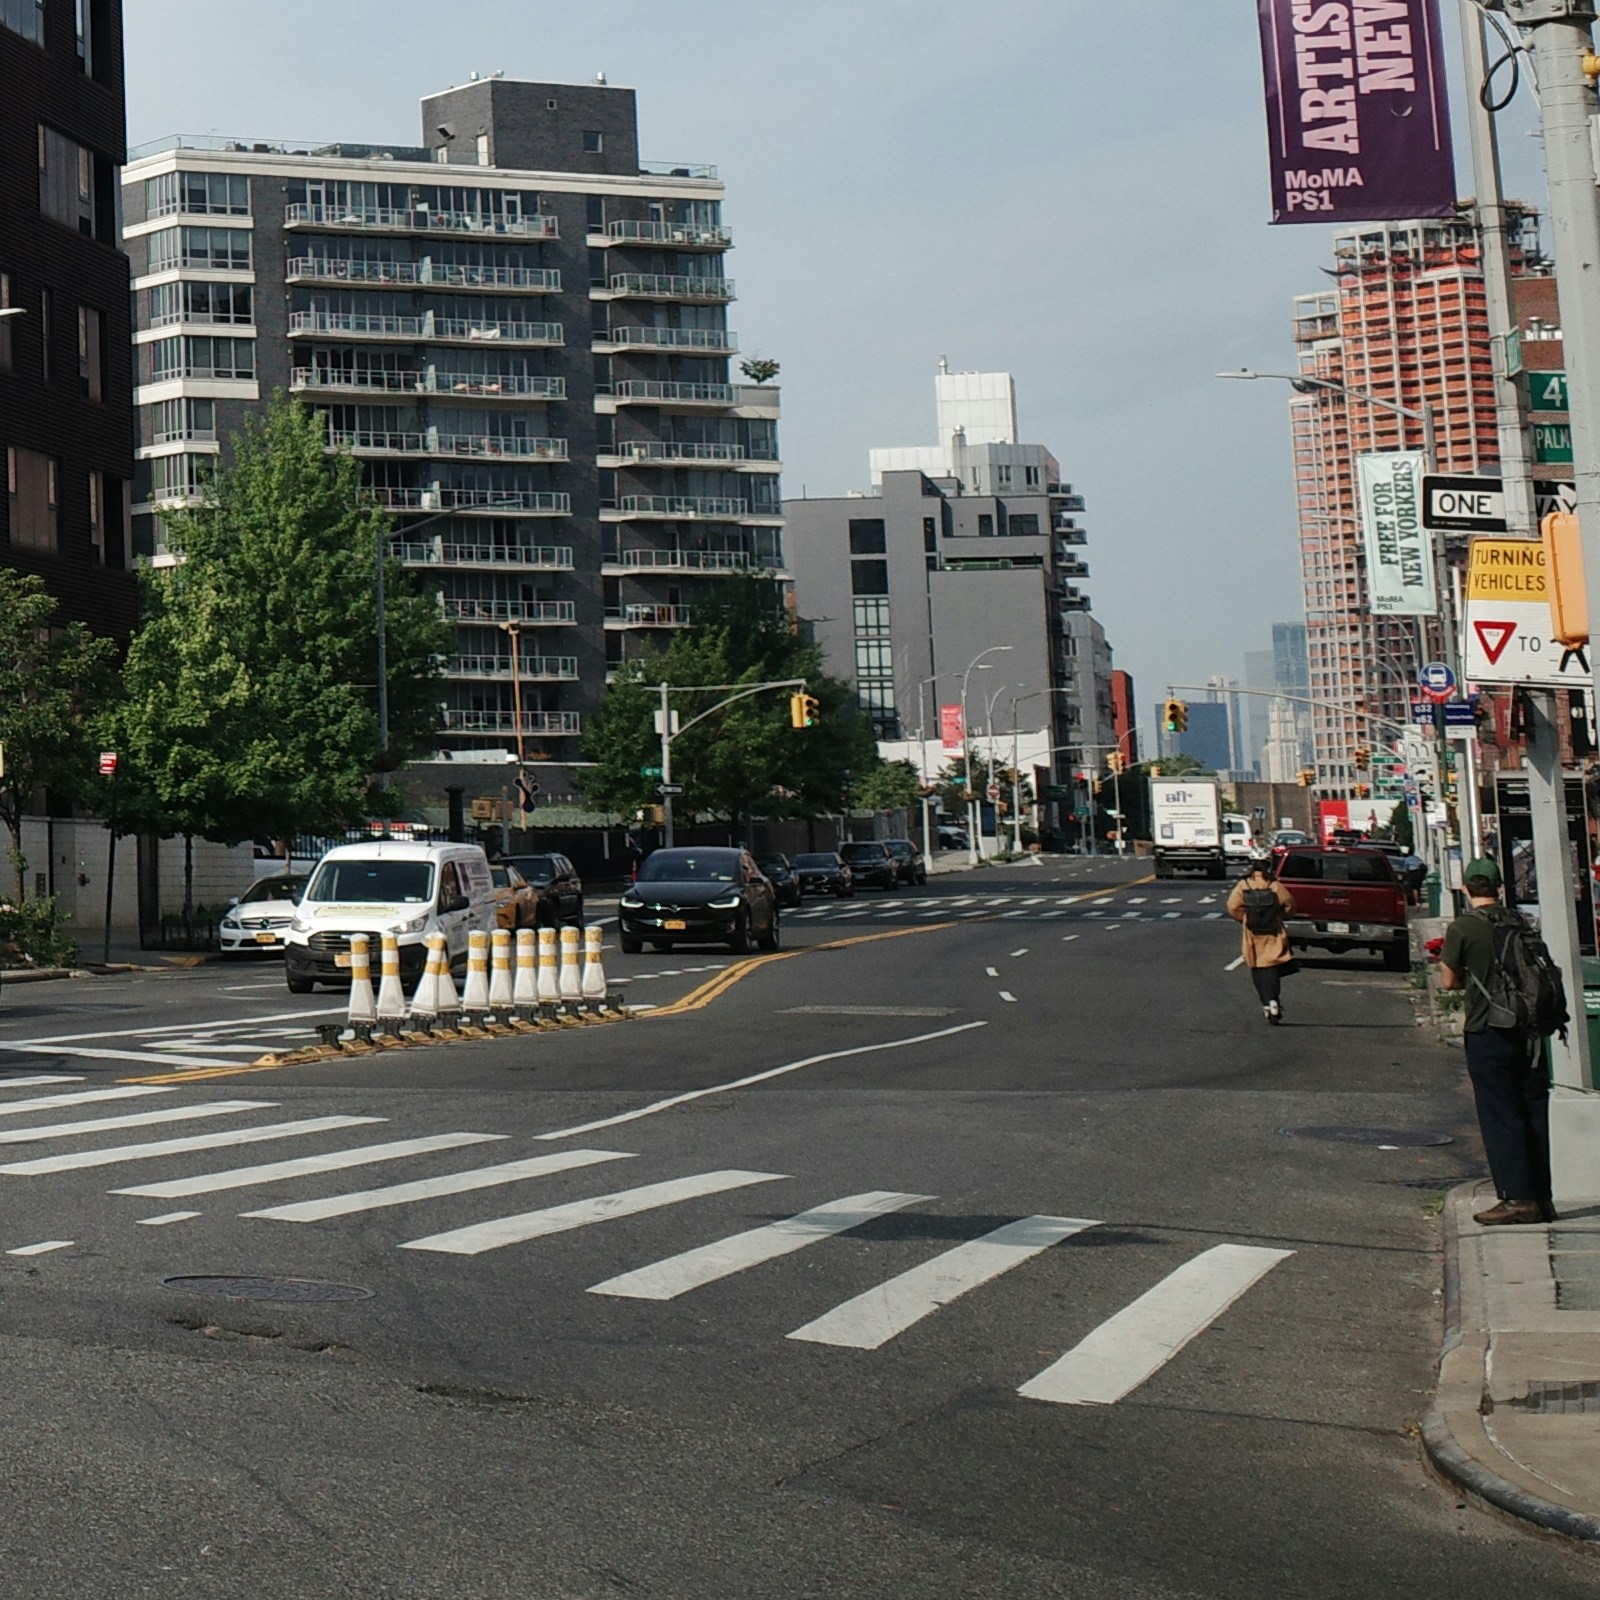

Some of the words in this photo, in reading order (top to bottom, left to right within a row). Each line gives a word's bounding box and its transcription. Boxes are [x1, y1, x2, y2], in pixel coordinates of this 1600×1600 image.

[1285, 168, 1364, 189] MoMA
[1286, 191, 1334, 211] PS1
[1542, 376, 1567, 408] 4
[1372, 481, 1393, 517] FOR
[1392, 460, 1419, 543] YORKERS
[1438, 493, 1492, 516] ONE
[1376, 520, 1399, 566] FREE
[1400, 545, 1423, 588] NEW
[1475, 549, 1546, 566] TURNING
[1474, 573, 1546, 591] VEHICLES
[1518, 636, 1542, 652] TO
